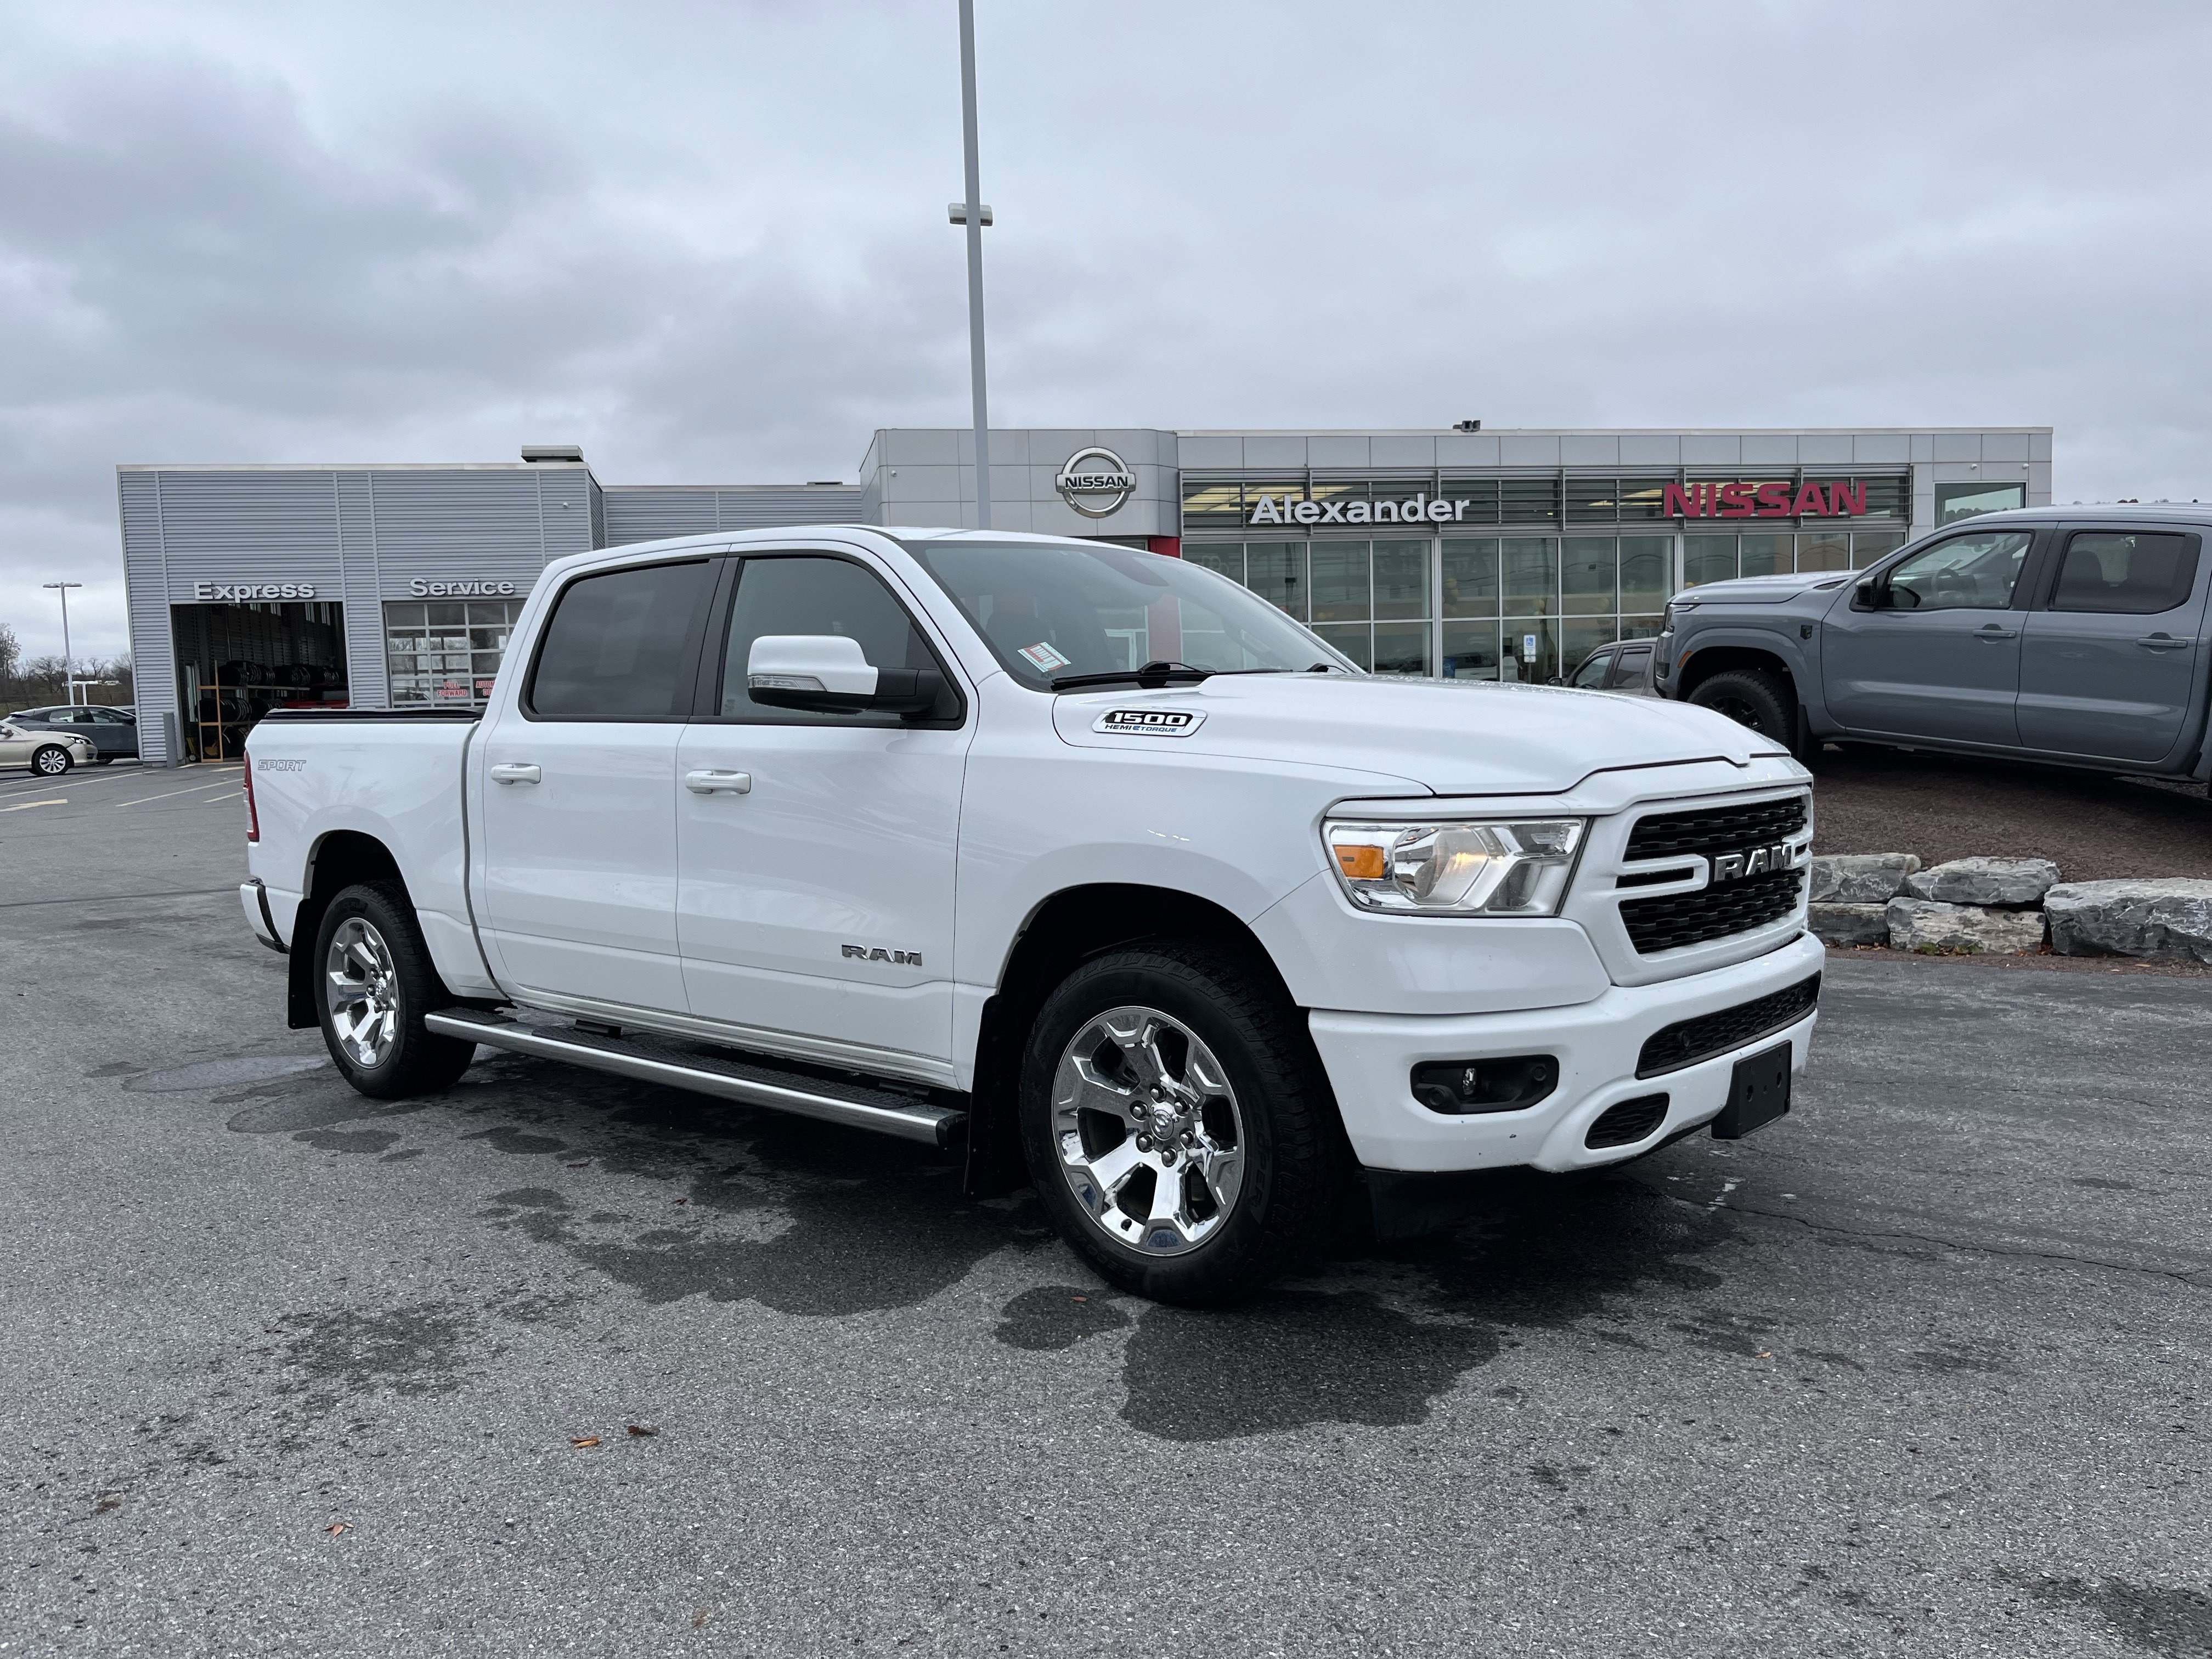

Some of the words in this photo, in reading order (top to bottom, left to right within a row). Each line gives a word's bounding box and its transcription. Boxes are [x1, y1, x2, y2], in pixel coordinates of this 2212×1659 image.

[1065, 476, 1128, 489] NISSAN
[1250, 493, 1470, 524] Alexander
[1664, 482, 1866, 517] NISSAN
[194, 581, 315, 603] Express
[410, 578, 515, 596] Service
[1114, 713, 1187, 725] 1500
[258, 759, 307, 771] SPORT
[1714, 844, 1791, 882] RAM
[842, 944, 922, 966] RAM
